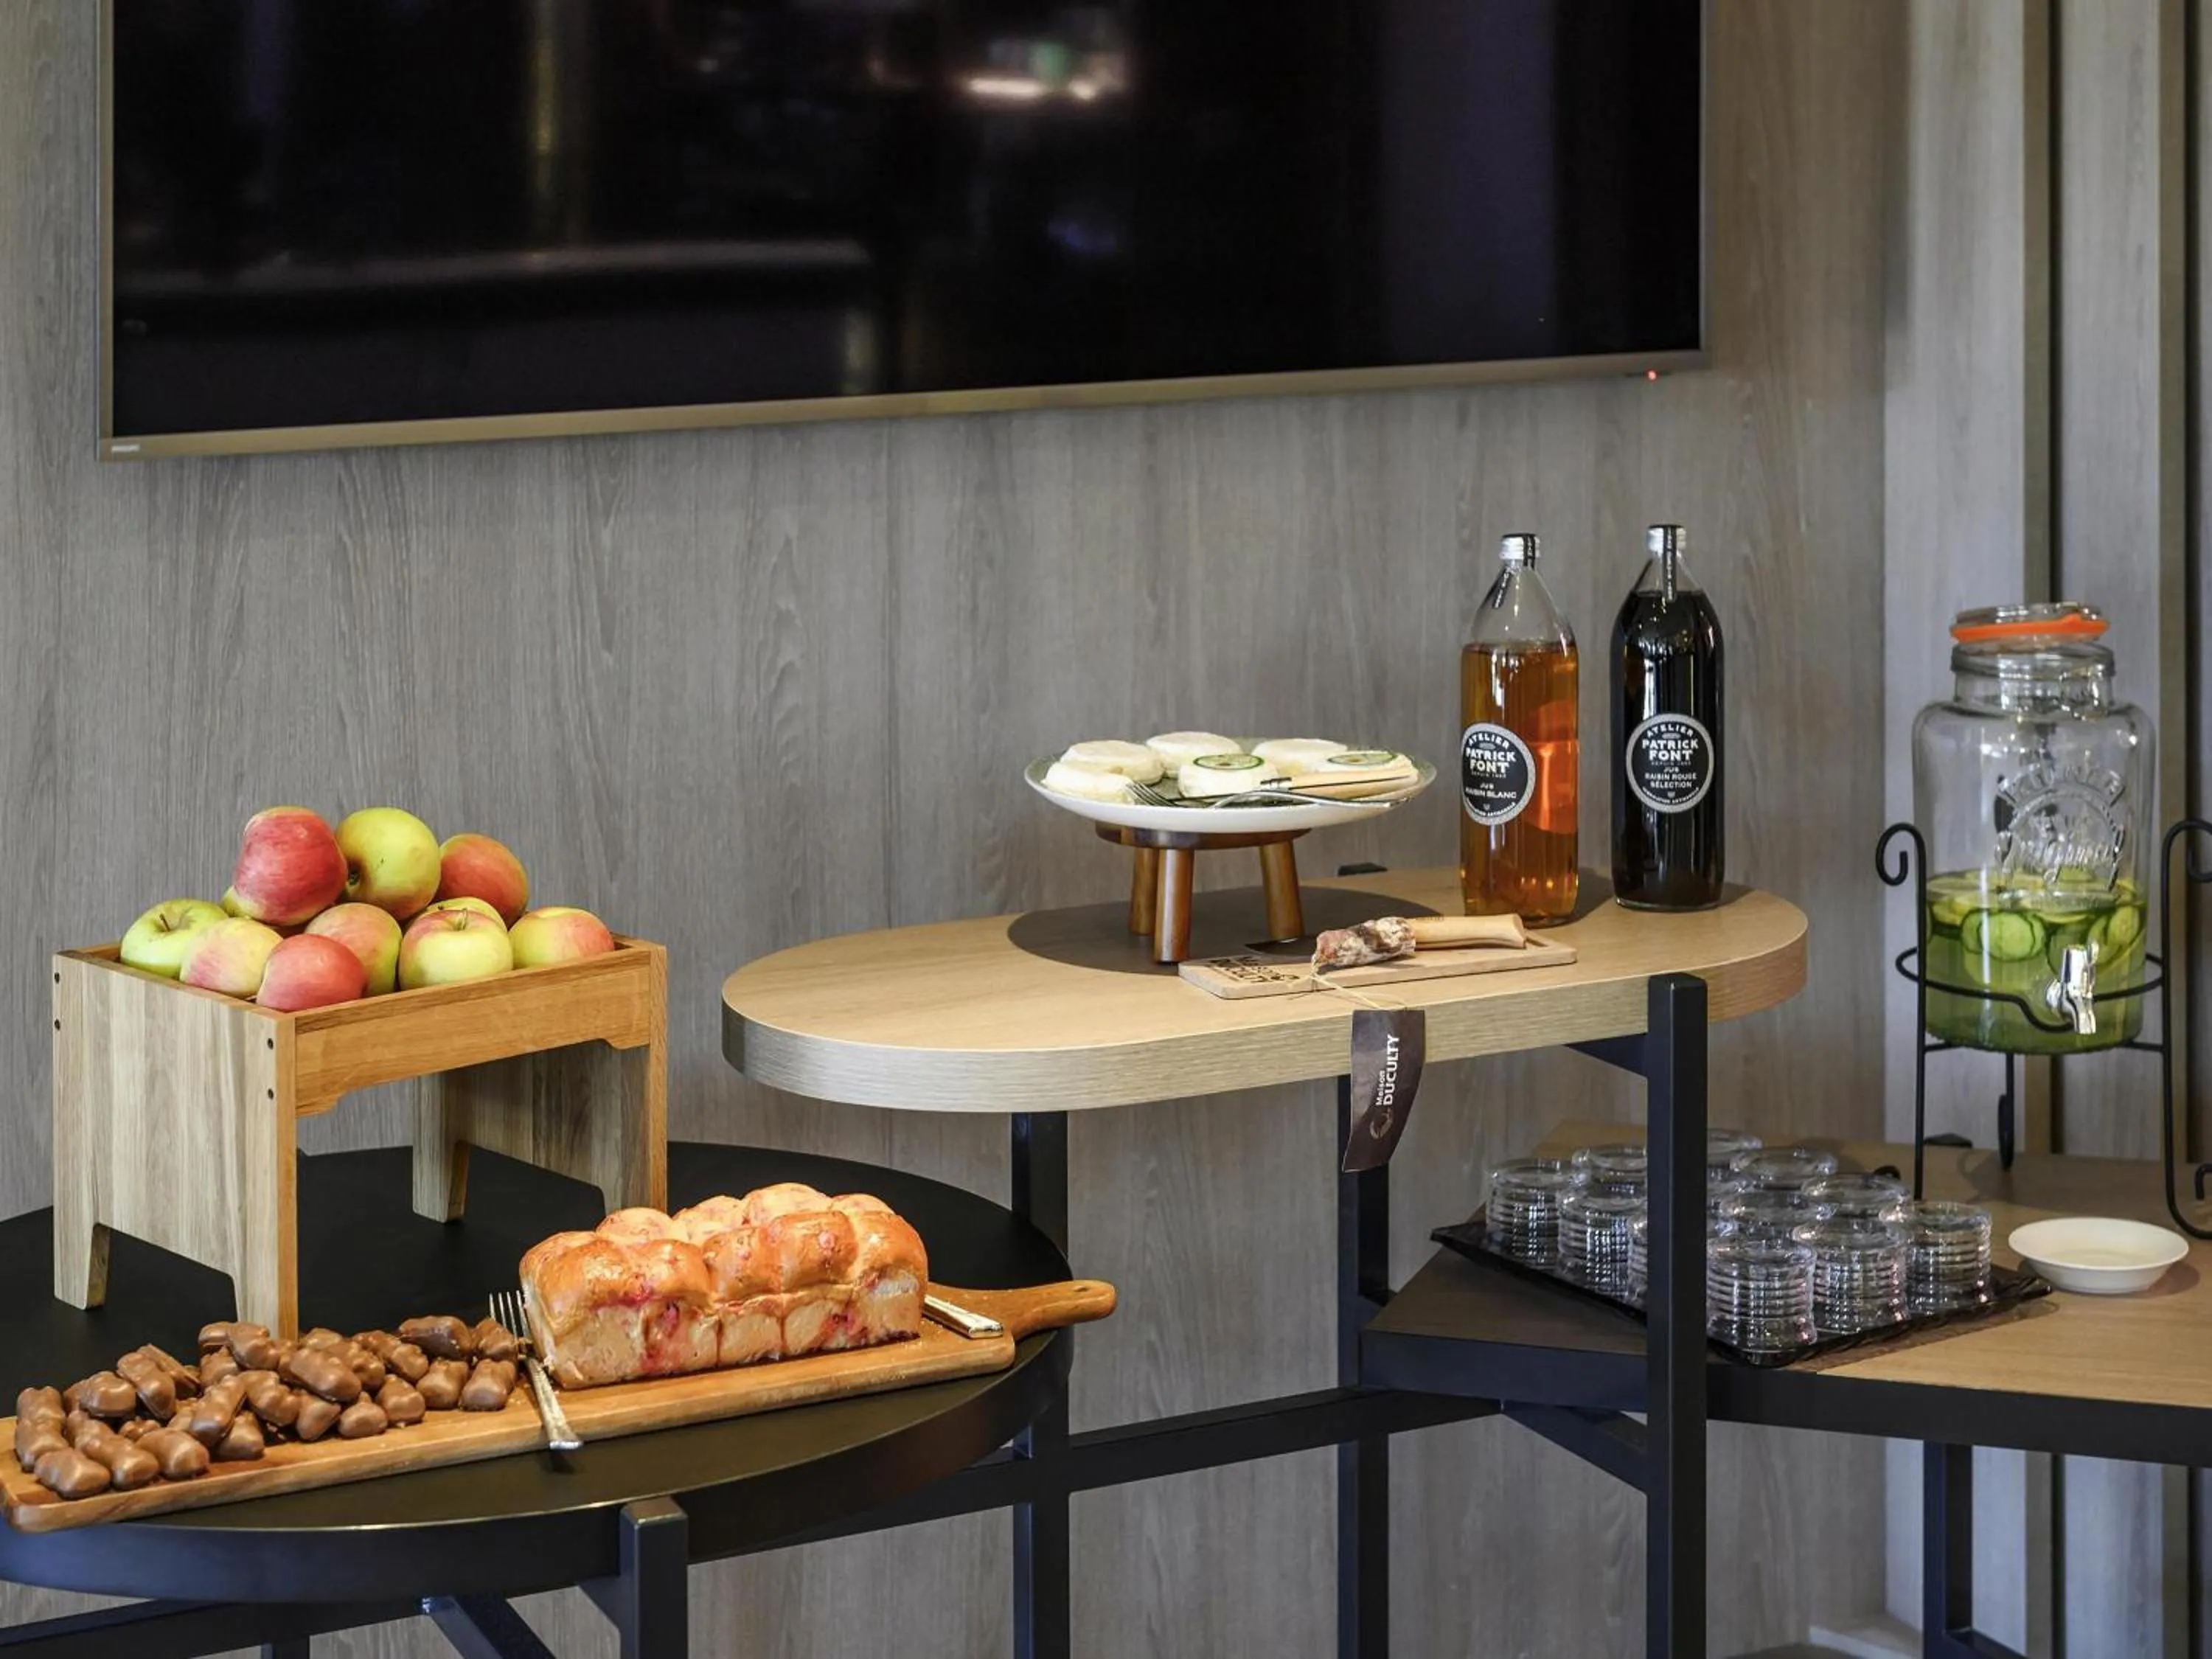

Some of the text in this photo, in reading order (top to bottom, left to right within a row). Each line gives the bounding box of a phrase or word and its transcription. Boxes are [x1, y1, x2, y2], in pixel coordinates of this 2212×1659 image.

[1646, 723, 1694, 737] ATELIER
[1468, 732, 1510, 749] ATELIER
[1642, 739, 1699, 750] PATRICK
[1465, 747, 1517, 762] PATRICK
[1649, 750, 1693, 762] FONT
[1470, 759, 1510, 773] FONT
[1645, 772, 1697, 781] RAISIN ROUGE
[1480, 782, 1495, 790] JUS
[1486, 790, 1517, 799] BLANC
[1383, 1034, 1400, 1106] DUCULTY
[1375, 1070, 1385, 1106] Maison
